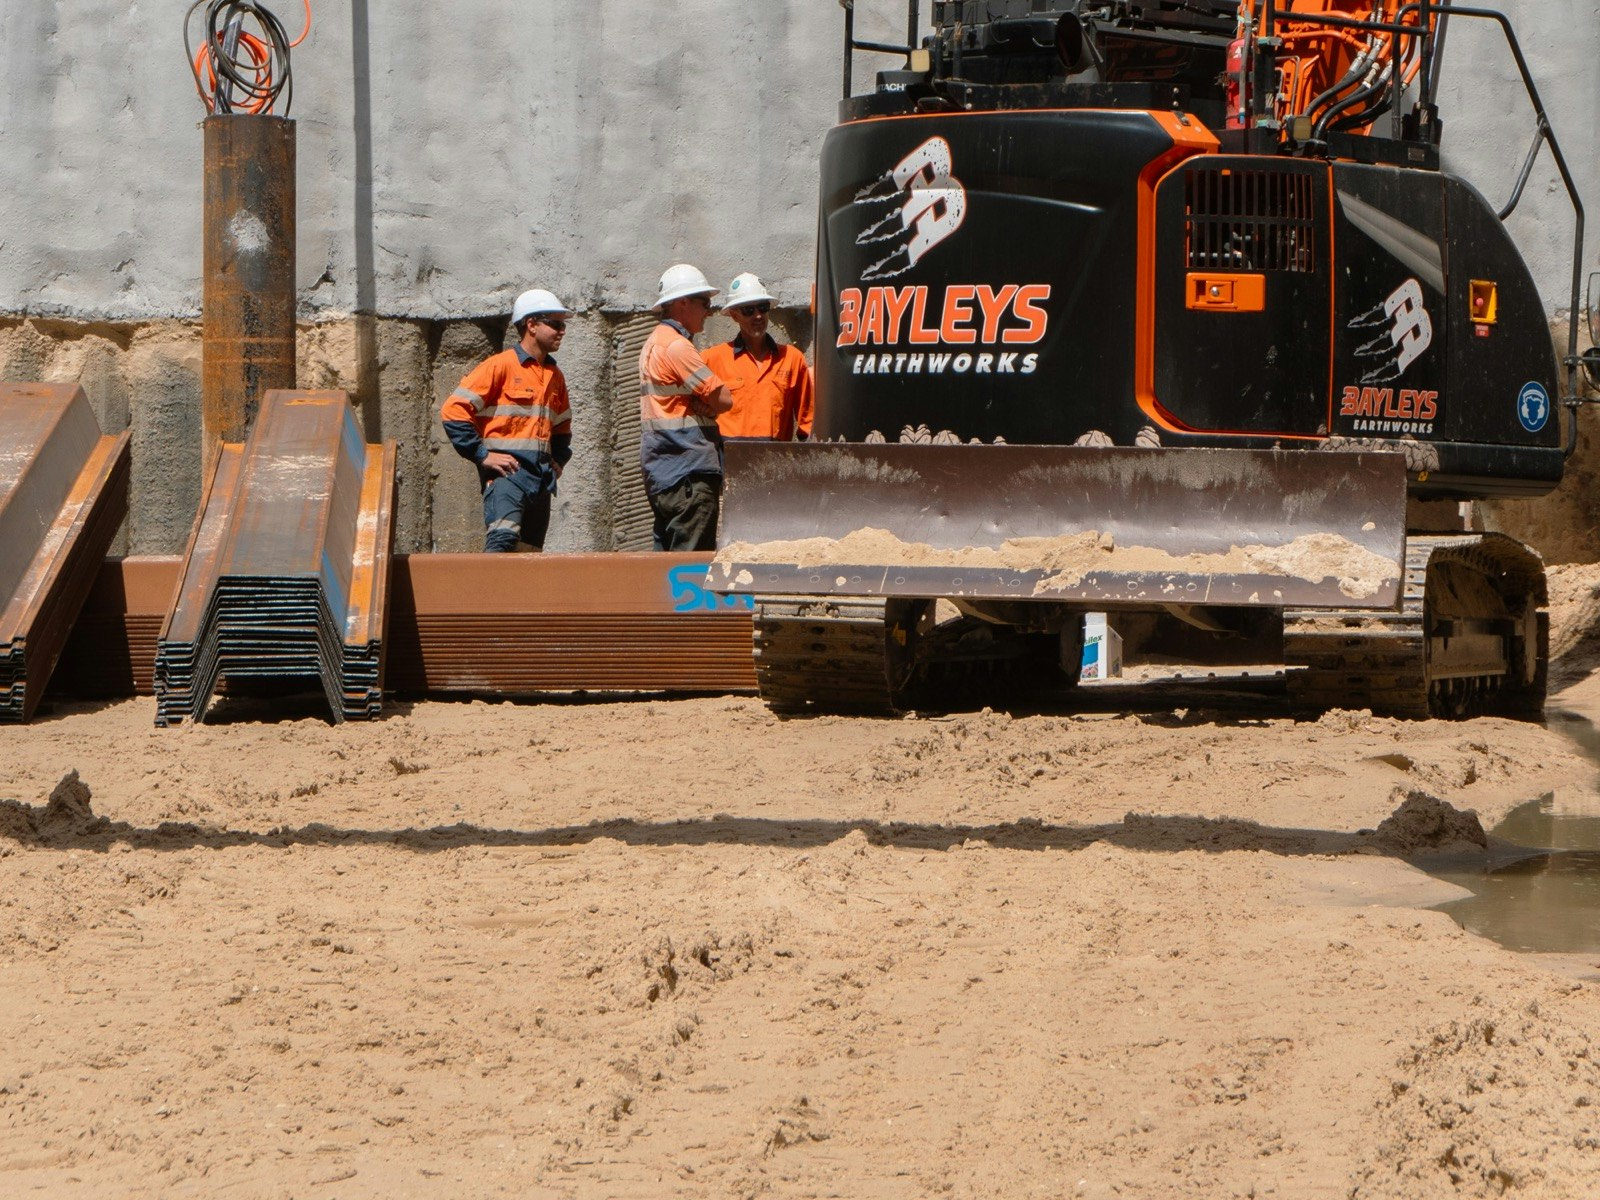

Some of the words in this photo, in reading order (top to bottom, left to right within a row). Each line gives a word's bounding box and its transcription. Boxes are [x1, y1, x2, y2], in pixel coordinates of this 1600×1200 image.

[837, 284, 1051, 348] BAYLEYS
[853, 353, 1039, 375] EARTHWORKS
[1340, 385, 1439, 420] BAYLEYS
[1353, 419, 1434, 434] EARTHWORKS
